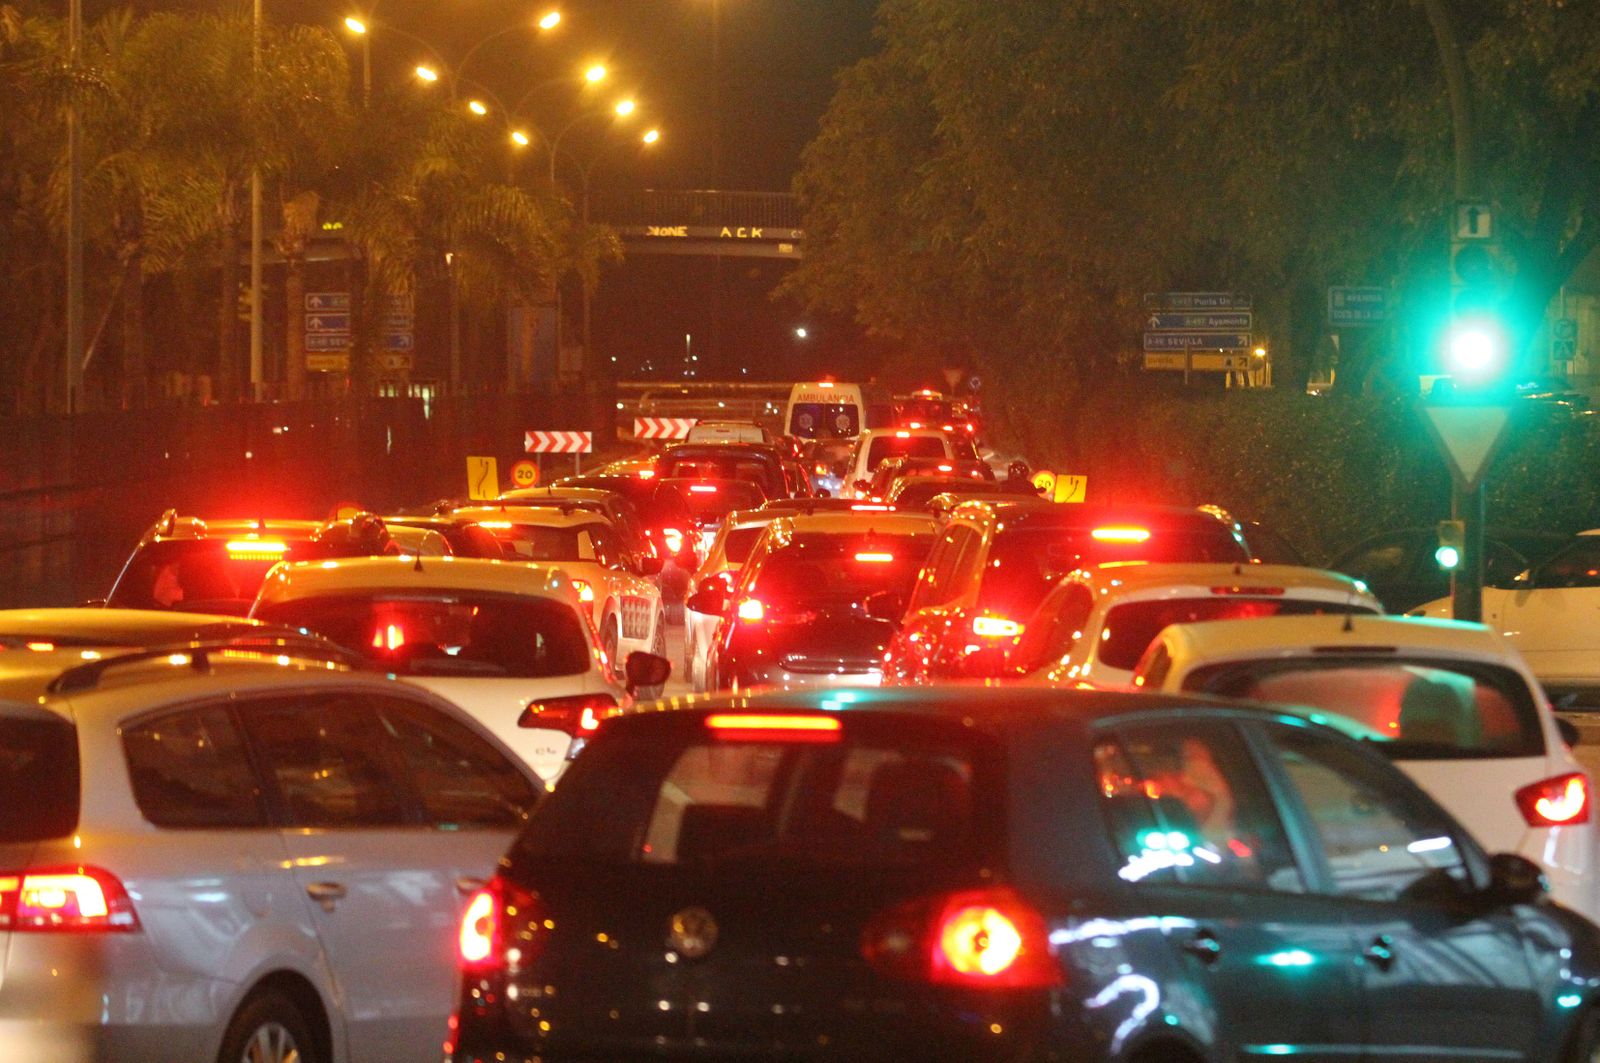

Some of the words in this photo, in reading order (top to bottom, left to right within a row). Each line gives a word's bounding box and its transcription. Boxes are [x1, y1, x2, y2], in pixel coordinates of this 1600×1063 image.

[1208, 317, 1248, 327] Ayamonte
[1167, 337, 1203, 345] SEVILLA
[797, 393, 854, 402] AMBULANCIA
[517, 470, 533, 479] 20
